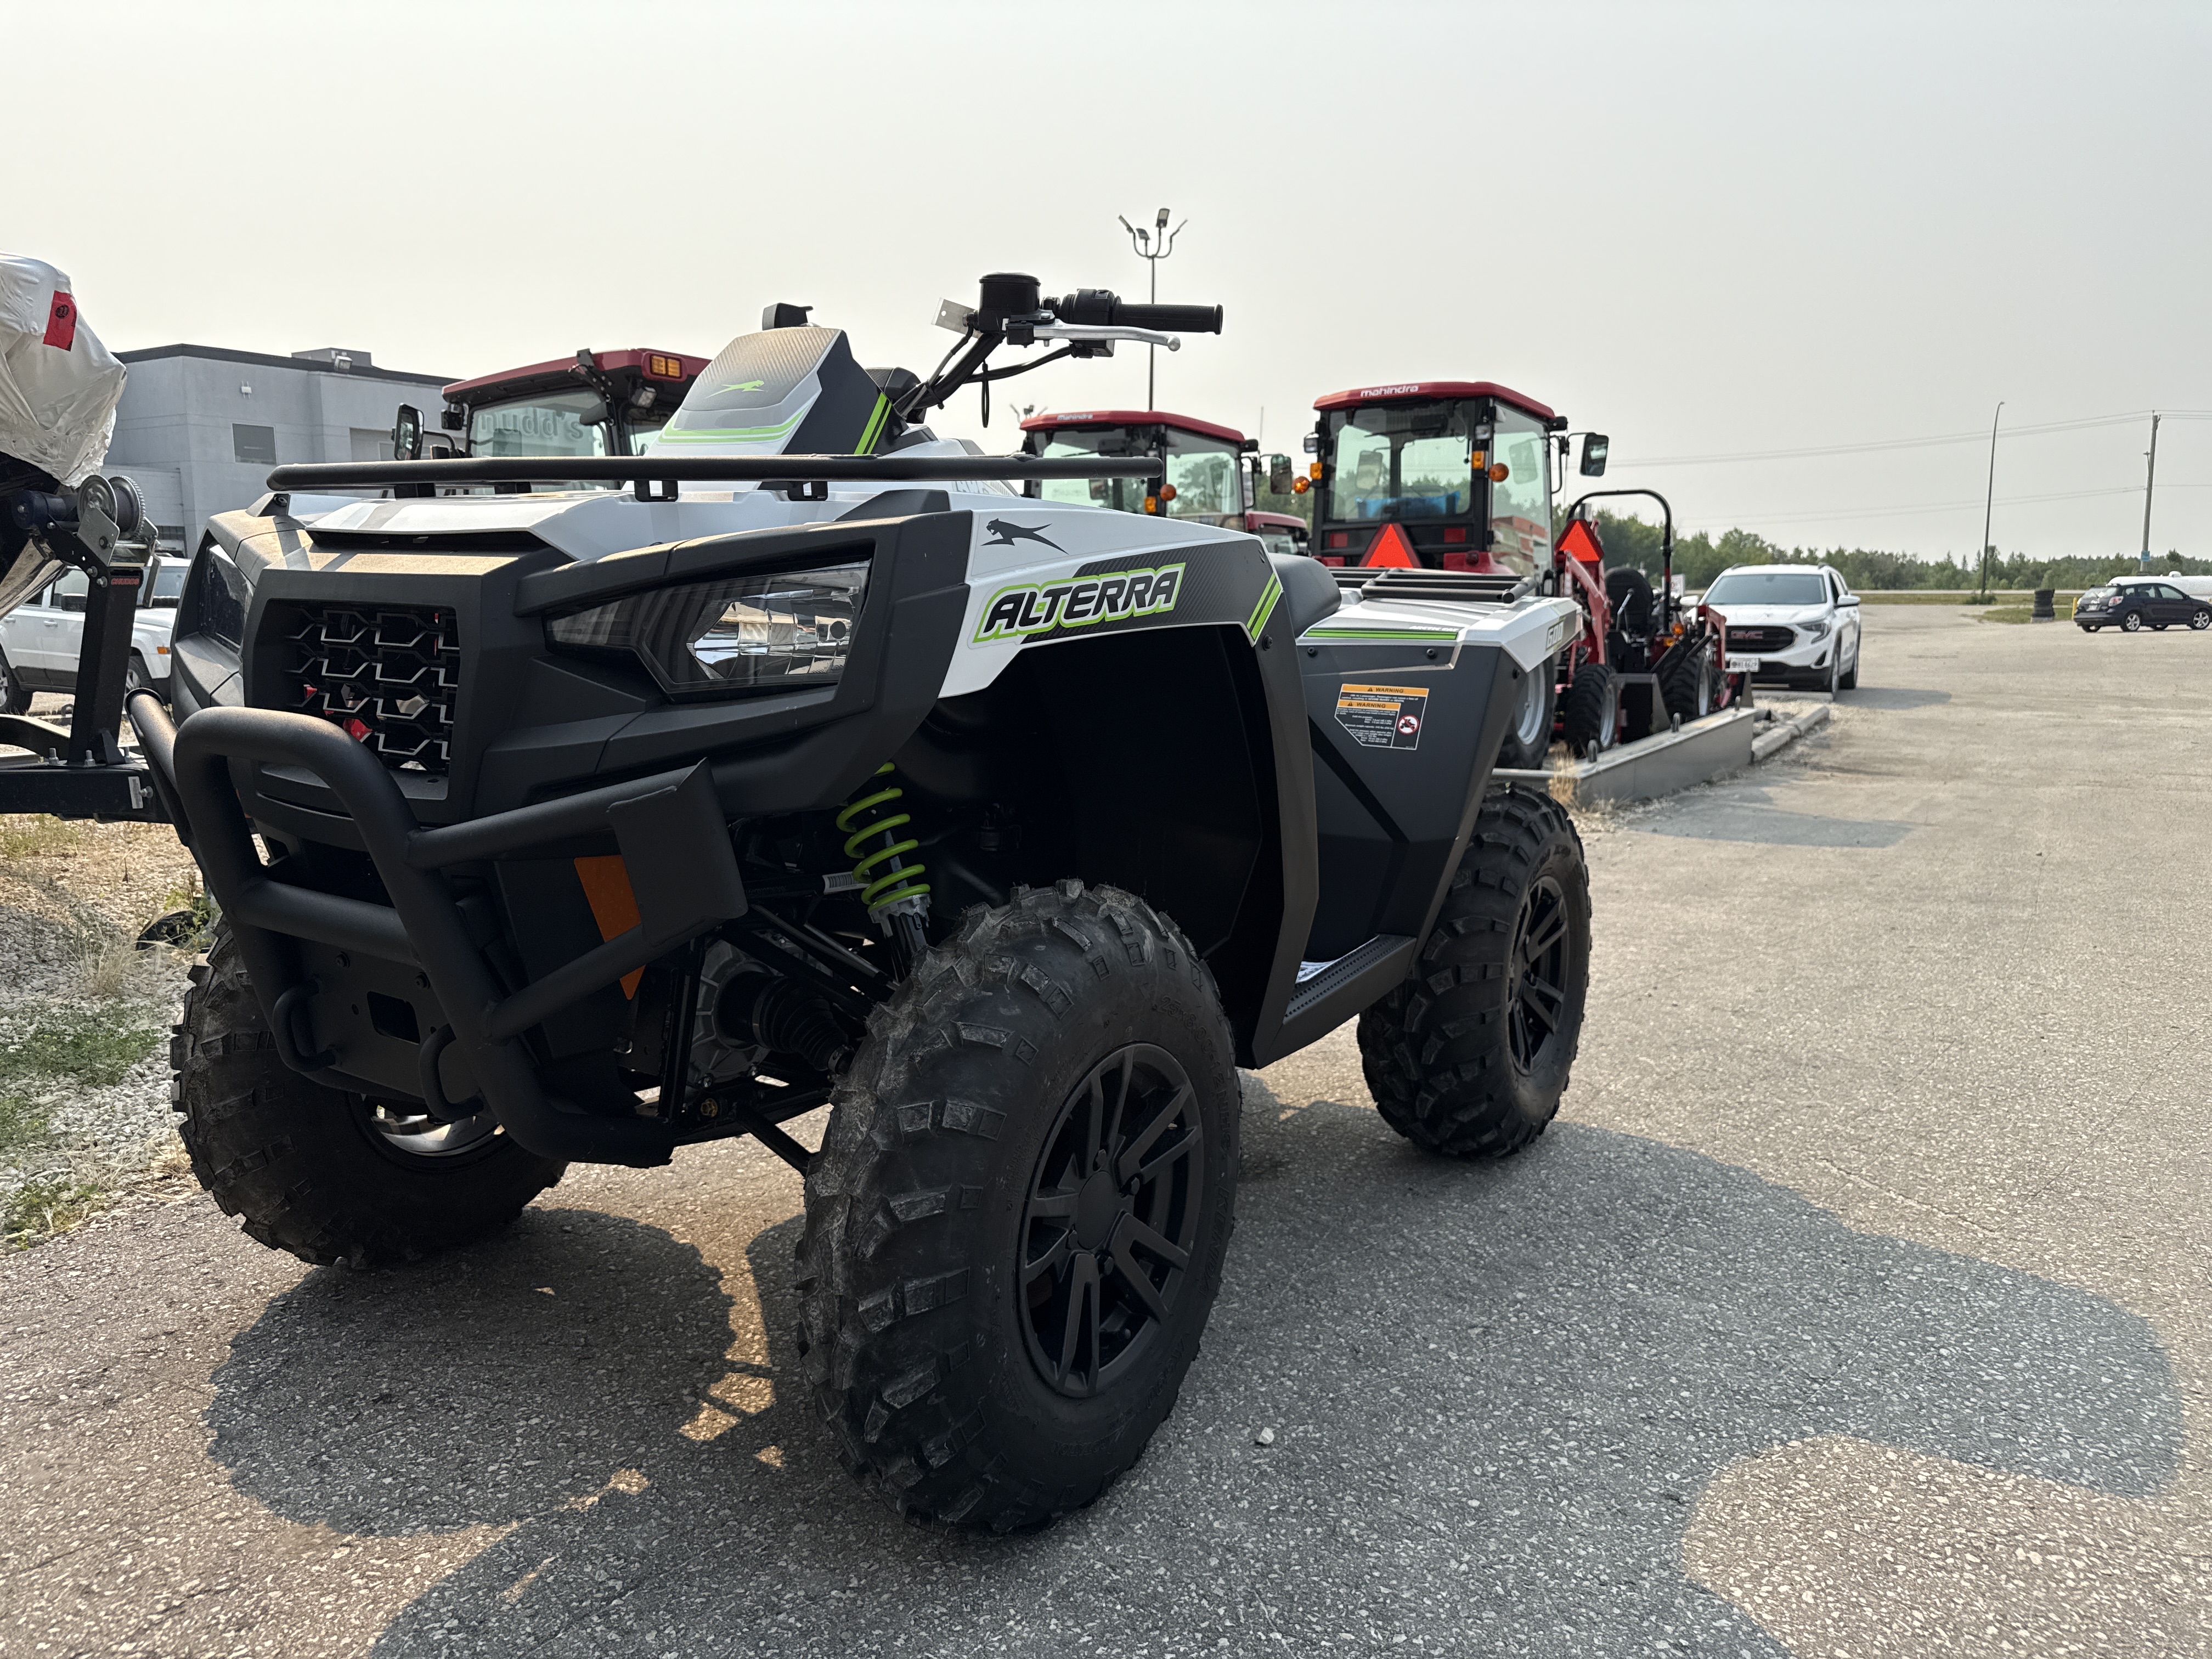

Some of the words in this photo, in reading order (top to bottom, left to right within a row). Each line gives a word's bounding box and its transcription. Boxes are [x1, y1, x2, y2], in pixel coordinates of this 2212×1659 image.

[1360, 383, 1419, 398] mahindra
[981, 571, 1179, 635] ALTERRA
[1730, 630, 1763, 640] GMC
